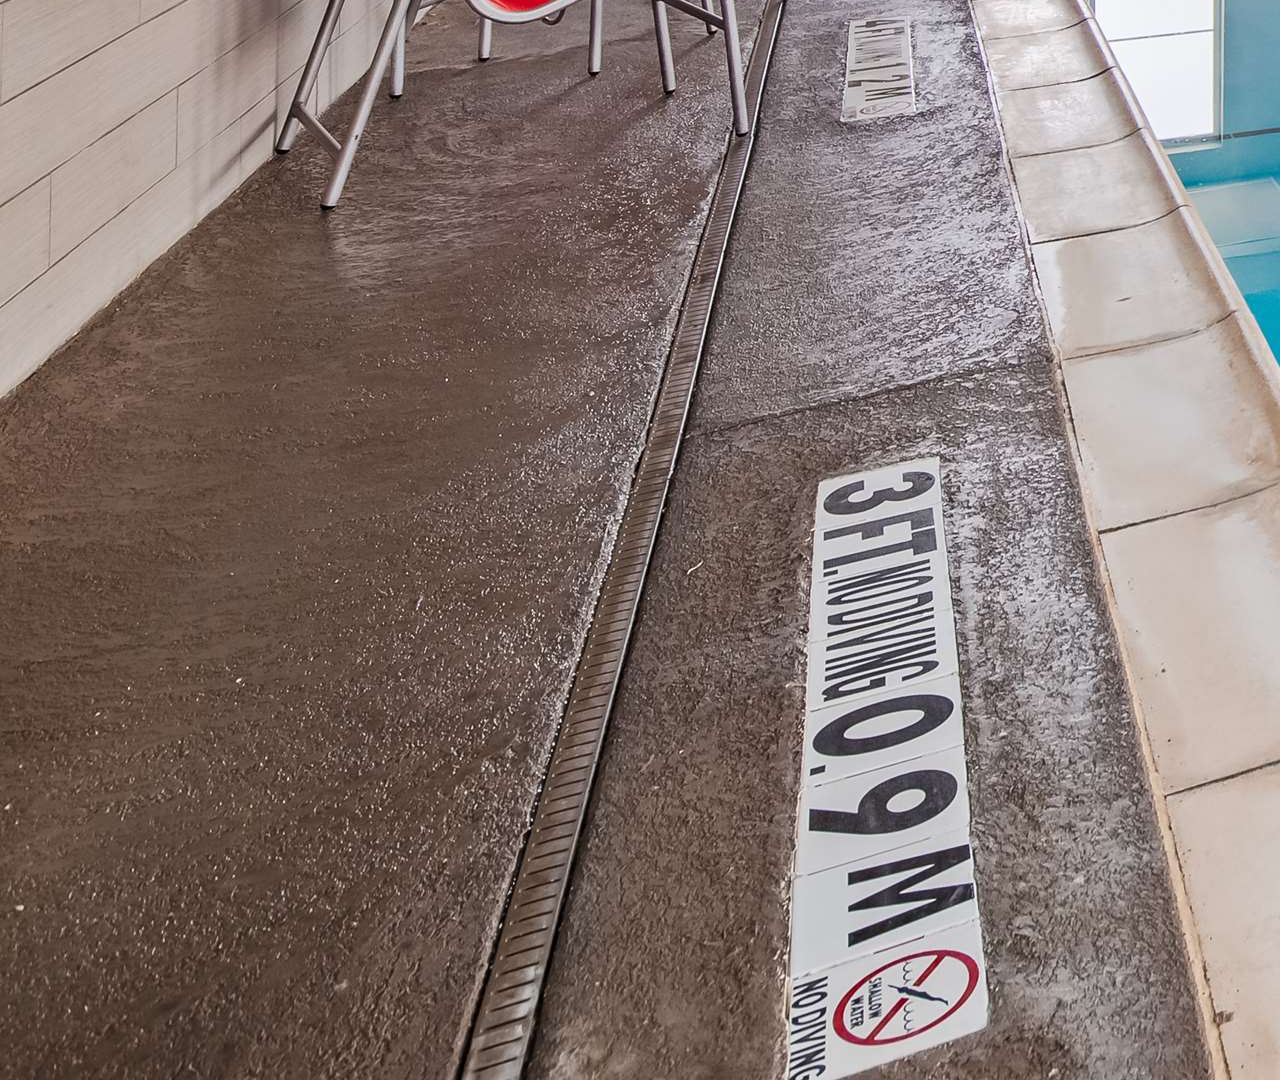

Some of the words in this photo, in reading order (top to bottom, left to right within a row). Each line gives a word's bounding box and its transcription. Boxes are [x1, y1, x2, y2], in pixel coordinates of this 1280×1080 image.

[823, 471, 936, 516] 3
[847, 843, 976, 948] M
[850, 994, 864, 1030] WATER
[868, 976, 882, 1020] SHALLOW
